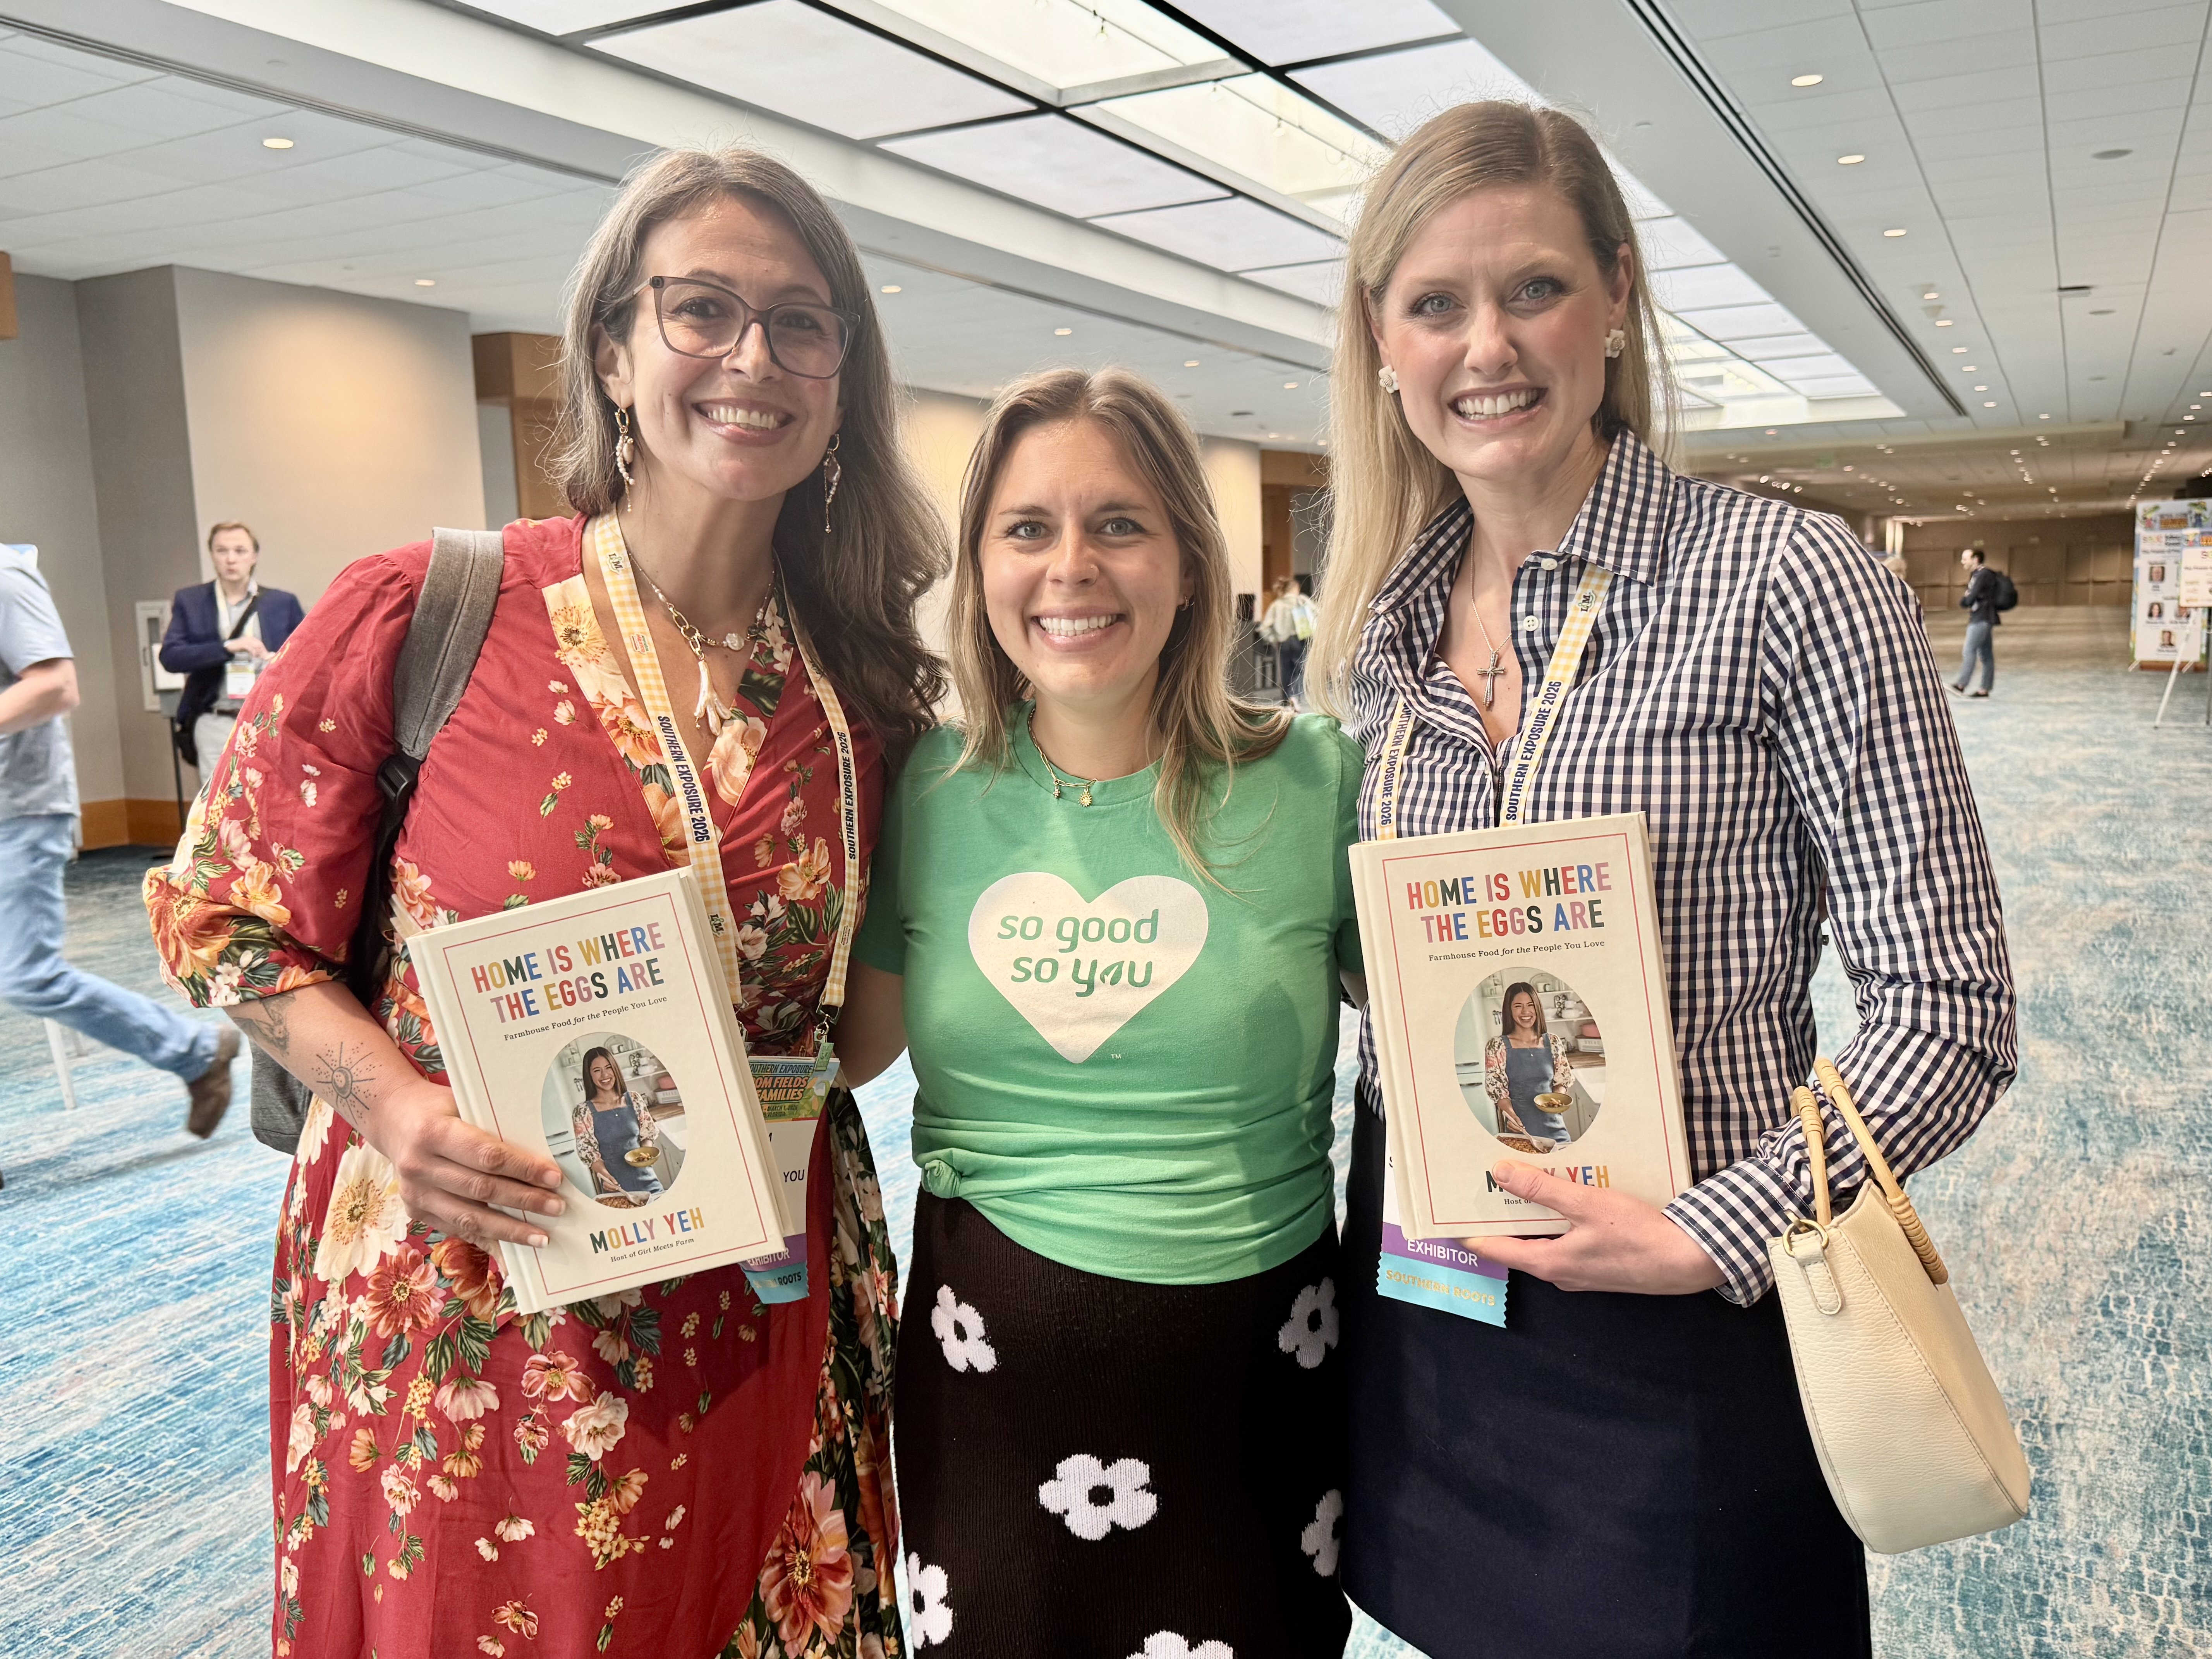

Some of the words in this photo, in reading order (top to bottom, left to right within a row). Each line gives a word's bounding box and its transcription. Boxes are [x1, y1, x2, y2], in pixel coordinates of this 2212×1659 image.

[837, 732, 848, 754] 2026
[1506, 763, 1529, 821] SOUTHERN
[1521, 708, 1550, 761] EXPOSURE
[1541, 681, 1561, 706] 2026
[658, 716, 686, 762] SOUTHERN
[676, 764, 703, 815] EXPOSURE
[691, 816, 710, 842] 2026
[843, 756, 854, 807] EXPOSURE
[1381, 749, 1400, 800] EXPOSURE
[1381, 800, 1391, 825] 2026
[846, 809, 855, 860] SOUTHERN
[1407, 876, 1477, 910] HOME
[1485, 873, 1510, 902] IS
[1518, 862, 1612, 898] WHERE
[997, 915, 1043, 940] so
[1056, 909, 1159, 953] good
[1420, 912, 1468, 943] THE
[1476, 905, 1543, 938] EGGS
[1554, 899, 1604, 931] ARE
[471, 952, 543, 993] HOME
[546, 945, 573, 974] IS
[577, 922, 665, 966] WHERE
[1011, 957, 1058, 982] so
[1429, 952, 1475, 961] Farmhouse
[1500, 948, 1514, 957] for
[1533, 944, 1562, 953] People
[1584, 939, 1605, 948] Love
[490, 988, 540, 1023] THE
[544, 972, 608, 1011] EGGS
[617, 958, 664, 994] ARE
[504, 1025, 550, 1041] Farmhouse
[551, 1018, 571, 1029] Food
[573, 1016, 585, 1025] for
[602, 1006, 629, 1017] People
[648, 996, 667, 1006] Love
[750, 1063, 779, 1073] OUTHERN
[780, 1065, 813, 1073] EXPOSURE
[753, 1077, 773, 1088] OM
[773, 1077, 809, 1088] FIELDS
[783, 1169, 805, 1183] YOU
[1566, 1165, 1609, 1188] YEH
[589, 1218, 655, 1254] MOLLY
[663, 1207, 704, 1235] YEH
[611, 1254, 627, 1262] Host
[653, 1243, 673, 1252] Meets
[676, 1238, 694, 1247] Farm
[1407, 1240, 1478, 1267] EXHIBITOR
[778, 1272, 801, 1286] ROOTS
[1386, 1269, 1449, 1295] SOUTHERN
[1453, 1286, 1496, 1306] ROOTS
